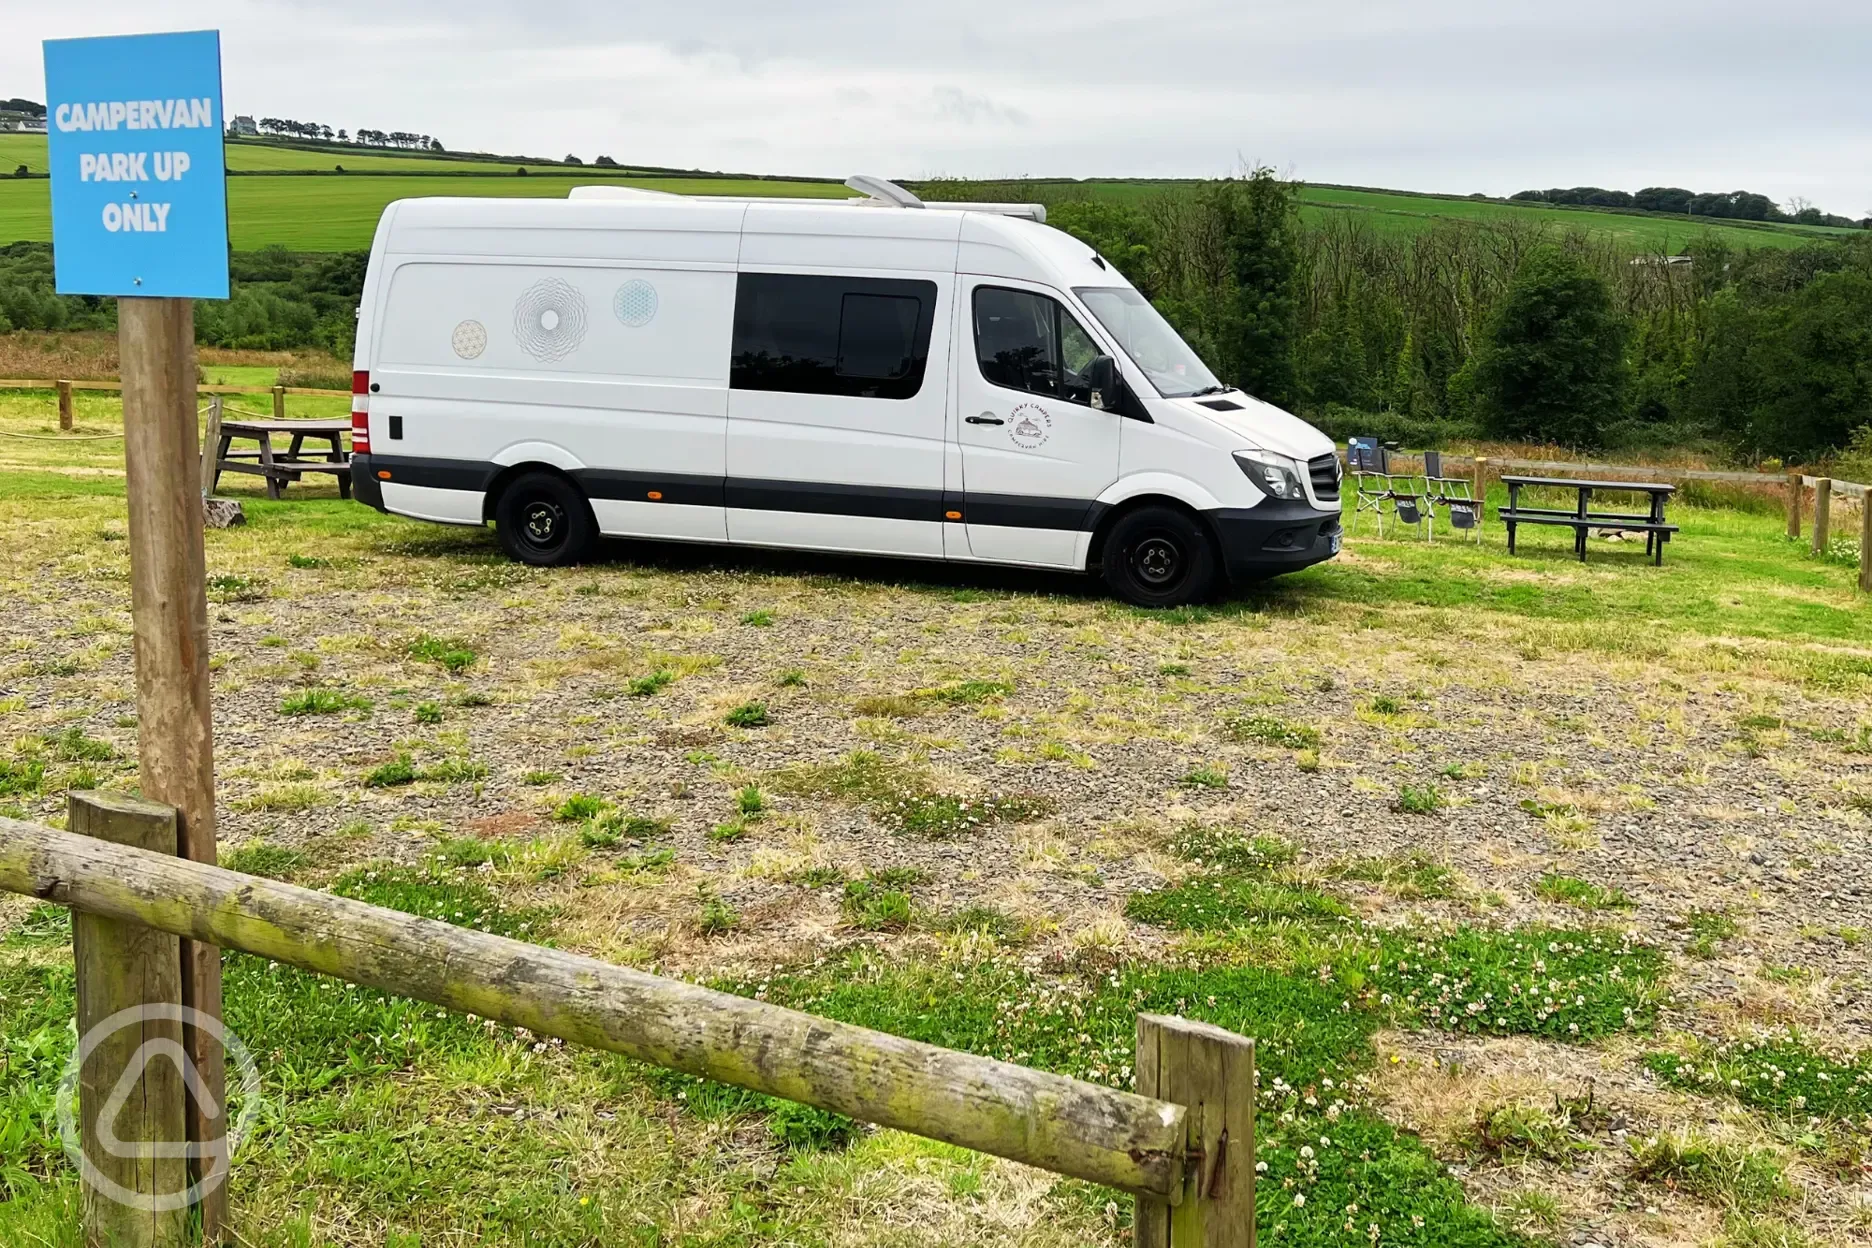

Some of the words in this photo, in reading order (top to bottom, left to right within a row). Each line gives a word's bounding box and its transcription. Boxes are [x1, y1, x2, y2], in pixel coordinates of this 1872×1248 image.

[56, 98, 212, 132] CAMPERVAN
[80, 153, 150, 182] PARK
[154, 151, 191, 181] UP
[102, 203, 171, 232] ONLY
[1007, 403, 1028, 424] QUIRKY
[1030, 403, 1052, 428] CAMPERS
